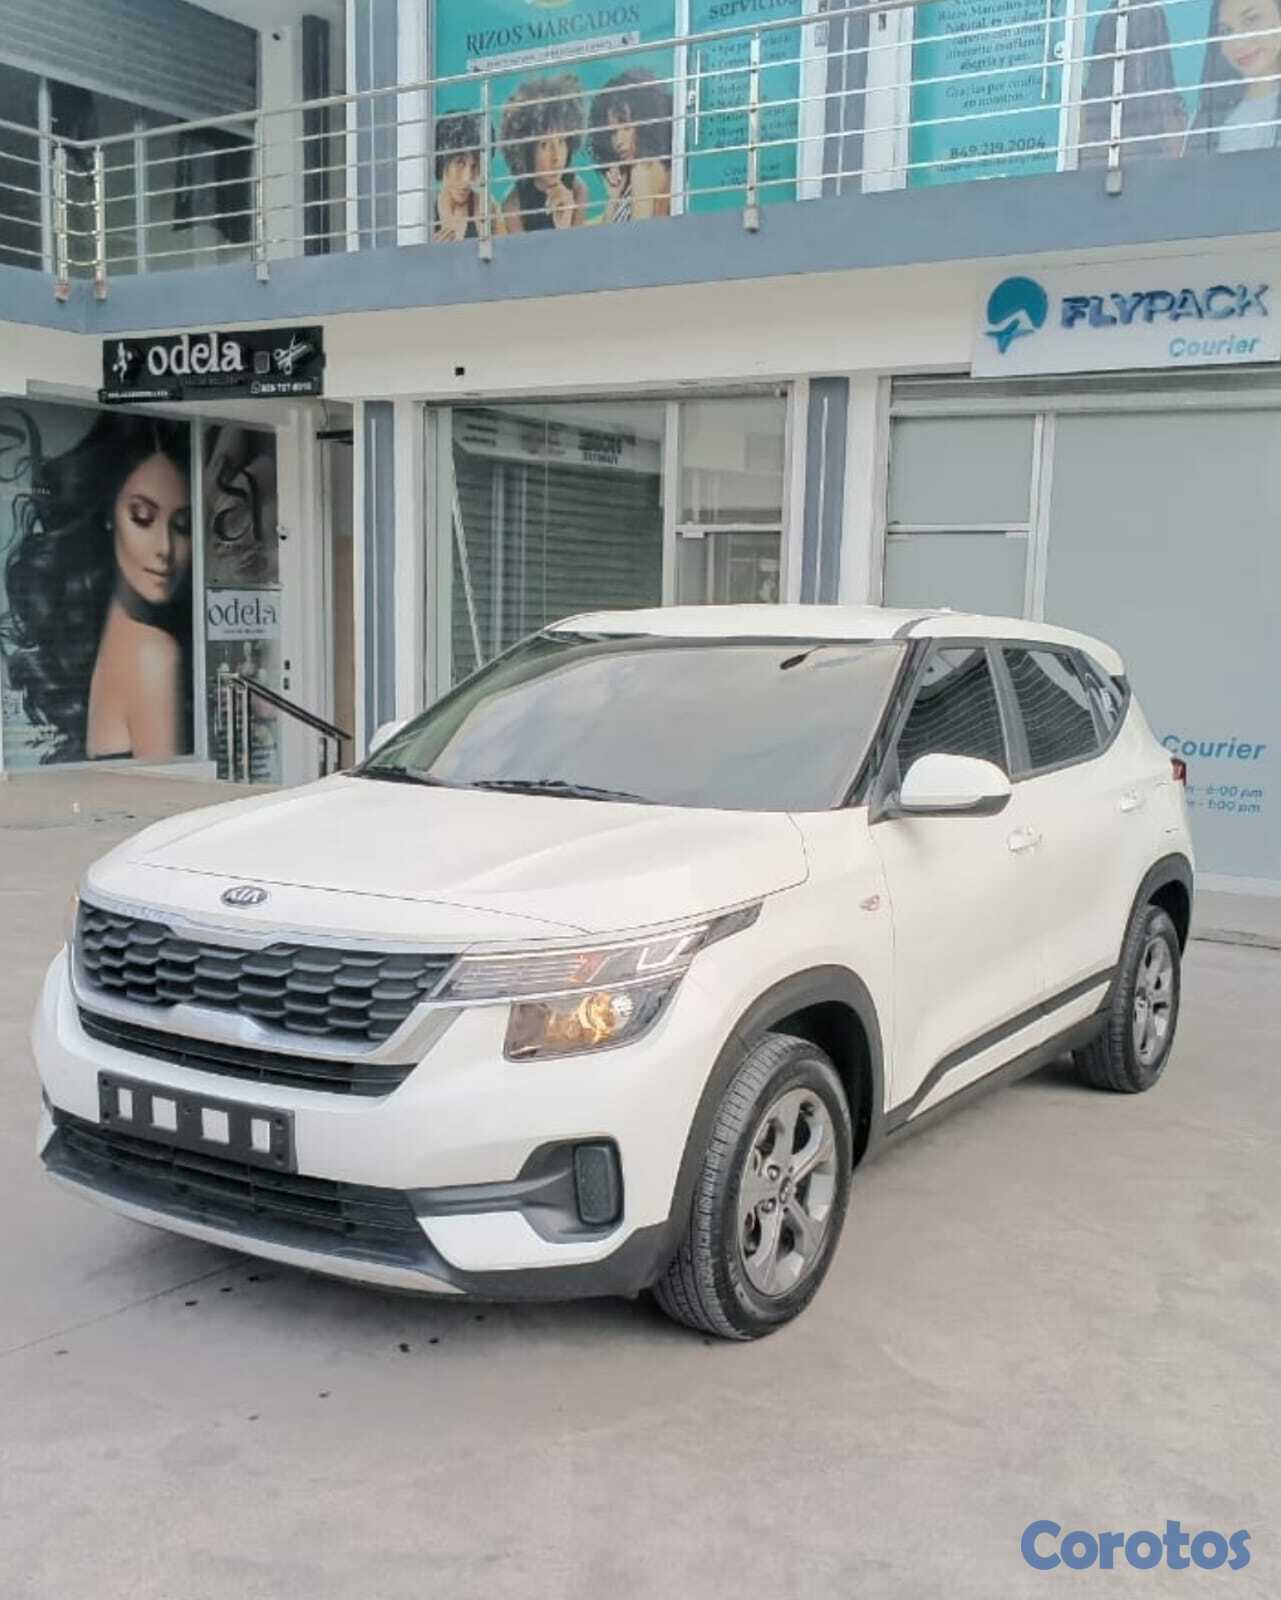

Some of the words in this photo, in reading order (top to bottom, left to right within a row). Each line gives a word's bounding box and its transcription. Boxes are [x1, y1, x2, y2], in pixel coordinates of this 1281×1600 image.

[466, 25, 523, 55] RIZOS
[527, 4, 640, 40] MARCADOS
[1008, 75, 1043, 89] confia
[1061, 284, 1269, 329] FLYPACK
[148, 332, 244, 376] odela
[1168, 333, 1260, 358] Courier
[208, 597, 277, 626] odela
[1161, 734, 1267, 760] Courier
[1240, 788, 1263, 798] pm
[1238, 803, 1261, 813] pm
[223, 887, 266, 904] KIA
